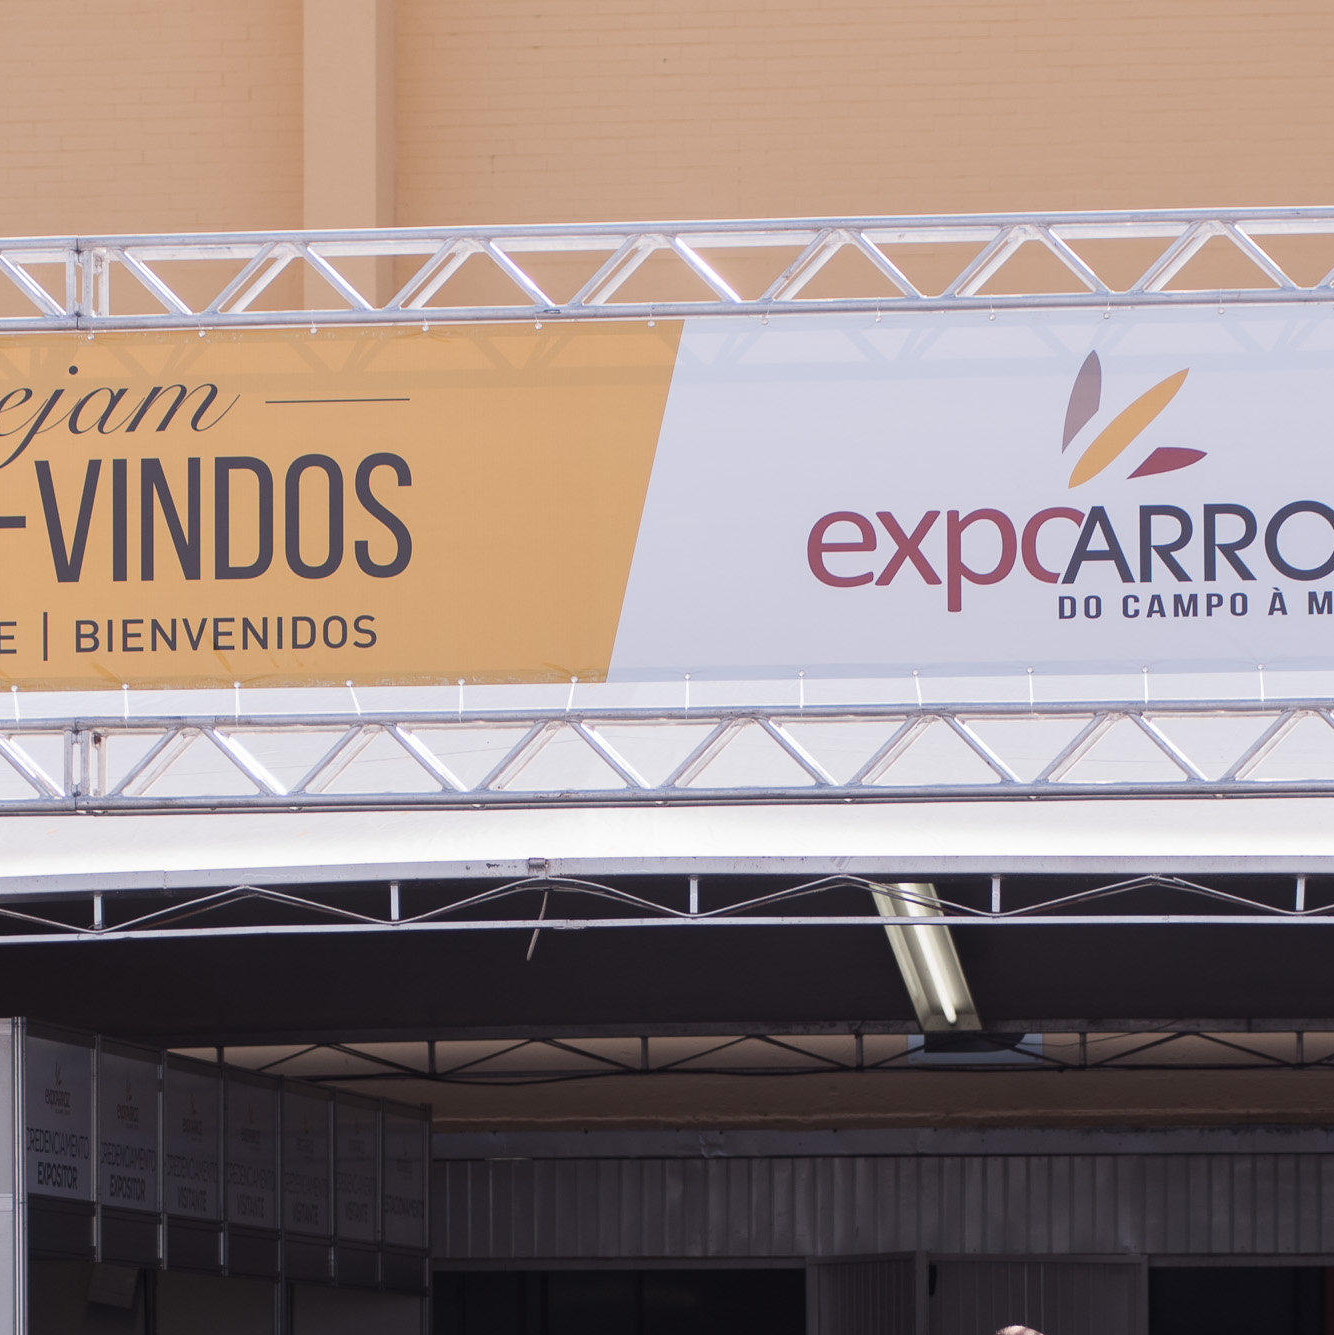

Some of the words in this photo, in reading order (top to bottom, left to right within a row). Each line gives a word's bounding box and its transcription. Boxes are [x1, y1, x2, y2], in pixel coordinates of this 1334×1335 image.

[1058, 594, 1102, 620] DO
[1121, 592, 1249, 619] CAMPO
[1267, 586, 1289, 616] À
[74, 614, 378, 654] BIENVENIDOS
[37, 1161, 78, 1189] EXPOSITOR
